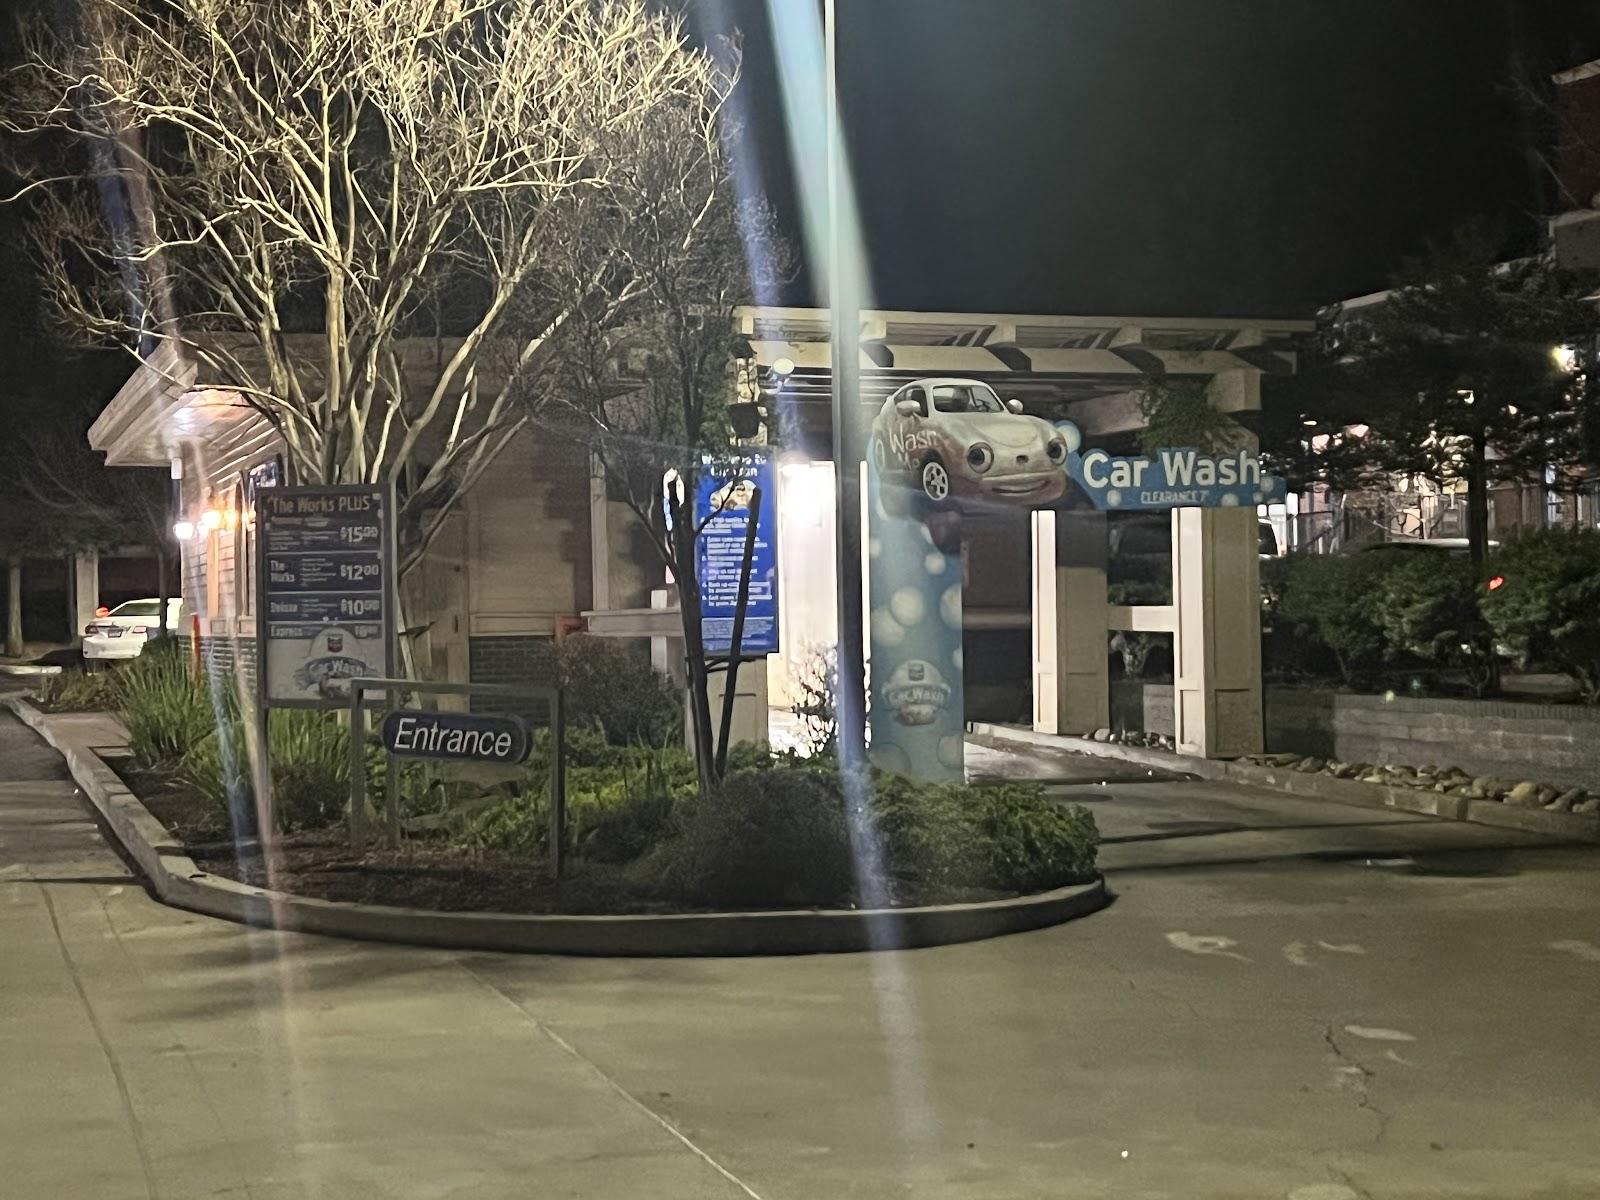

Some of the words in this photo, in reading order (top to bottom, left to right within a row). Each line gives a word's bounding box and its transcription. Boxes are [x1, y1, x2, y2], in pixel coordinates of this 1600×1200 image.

[888, 422, 938, 453] Wash
[1083, 452, 1149, 489] Car
[1161, 449, 1260, 487] Wash
[298, 497, 335, 512] Works
[339, 495, 370, 511] PLUS
[1141, 490, 1198, 504] CLEARANCE
[331, 660, 363, 676] Wash
[394, 717, 512, 757] Entrance
